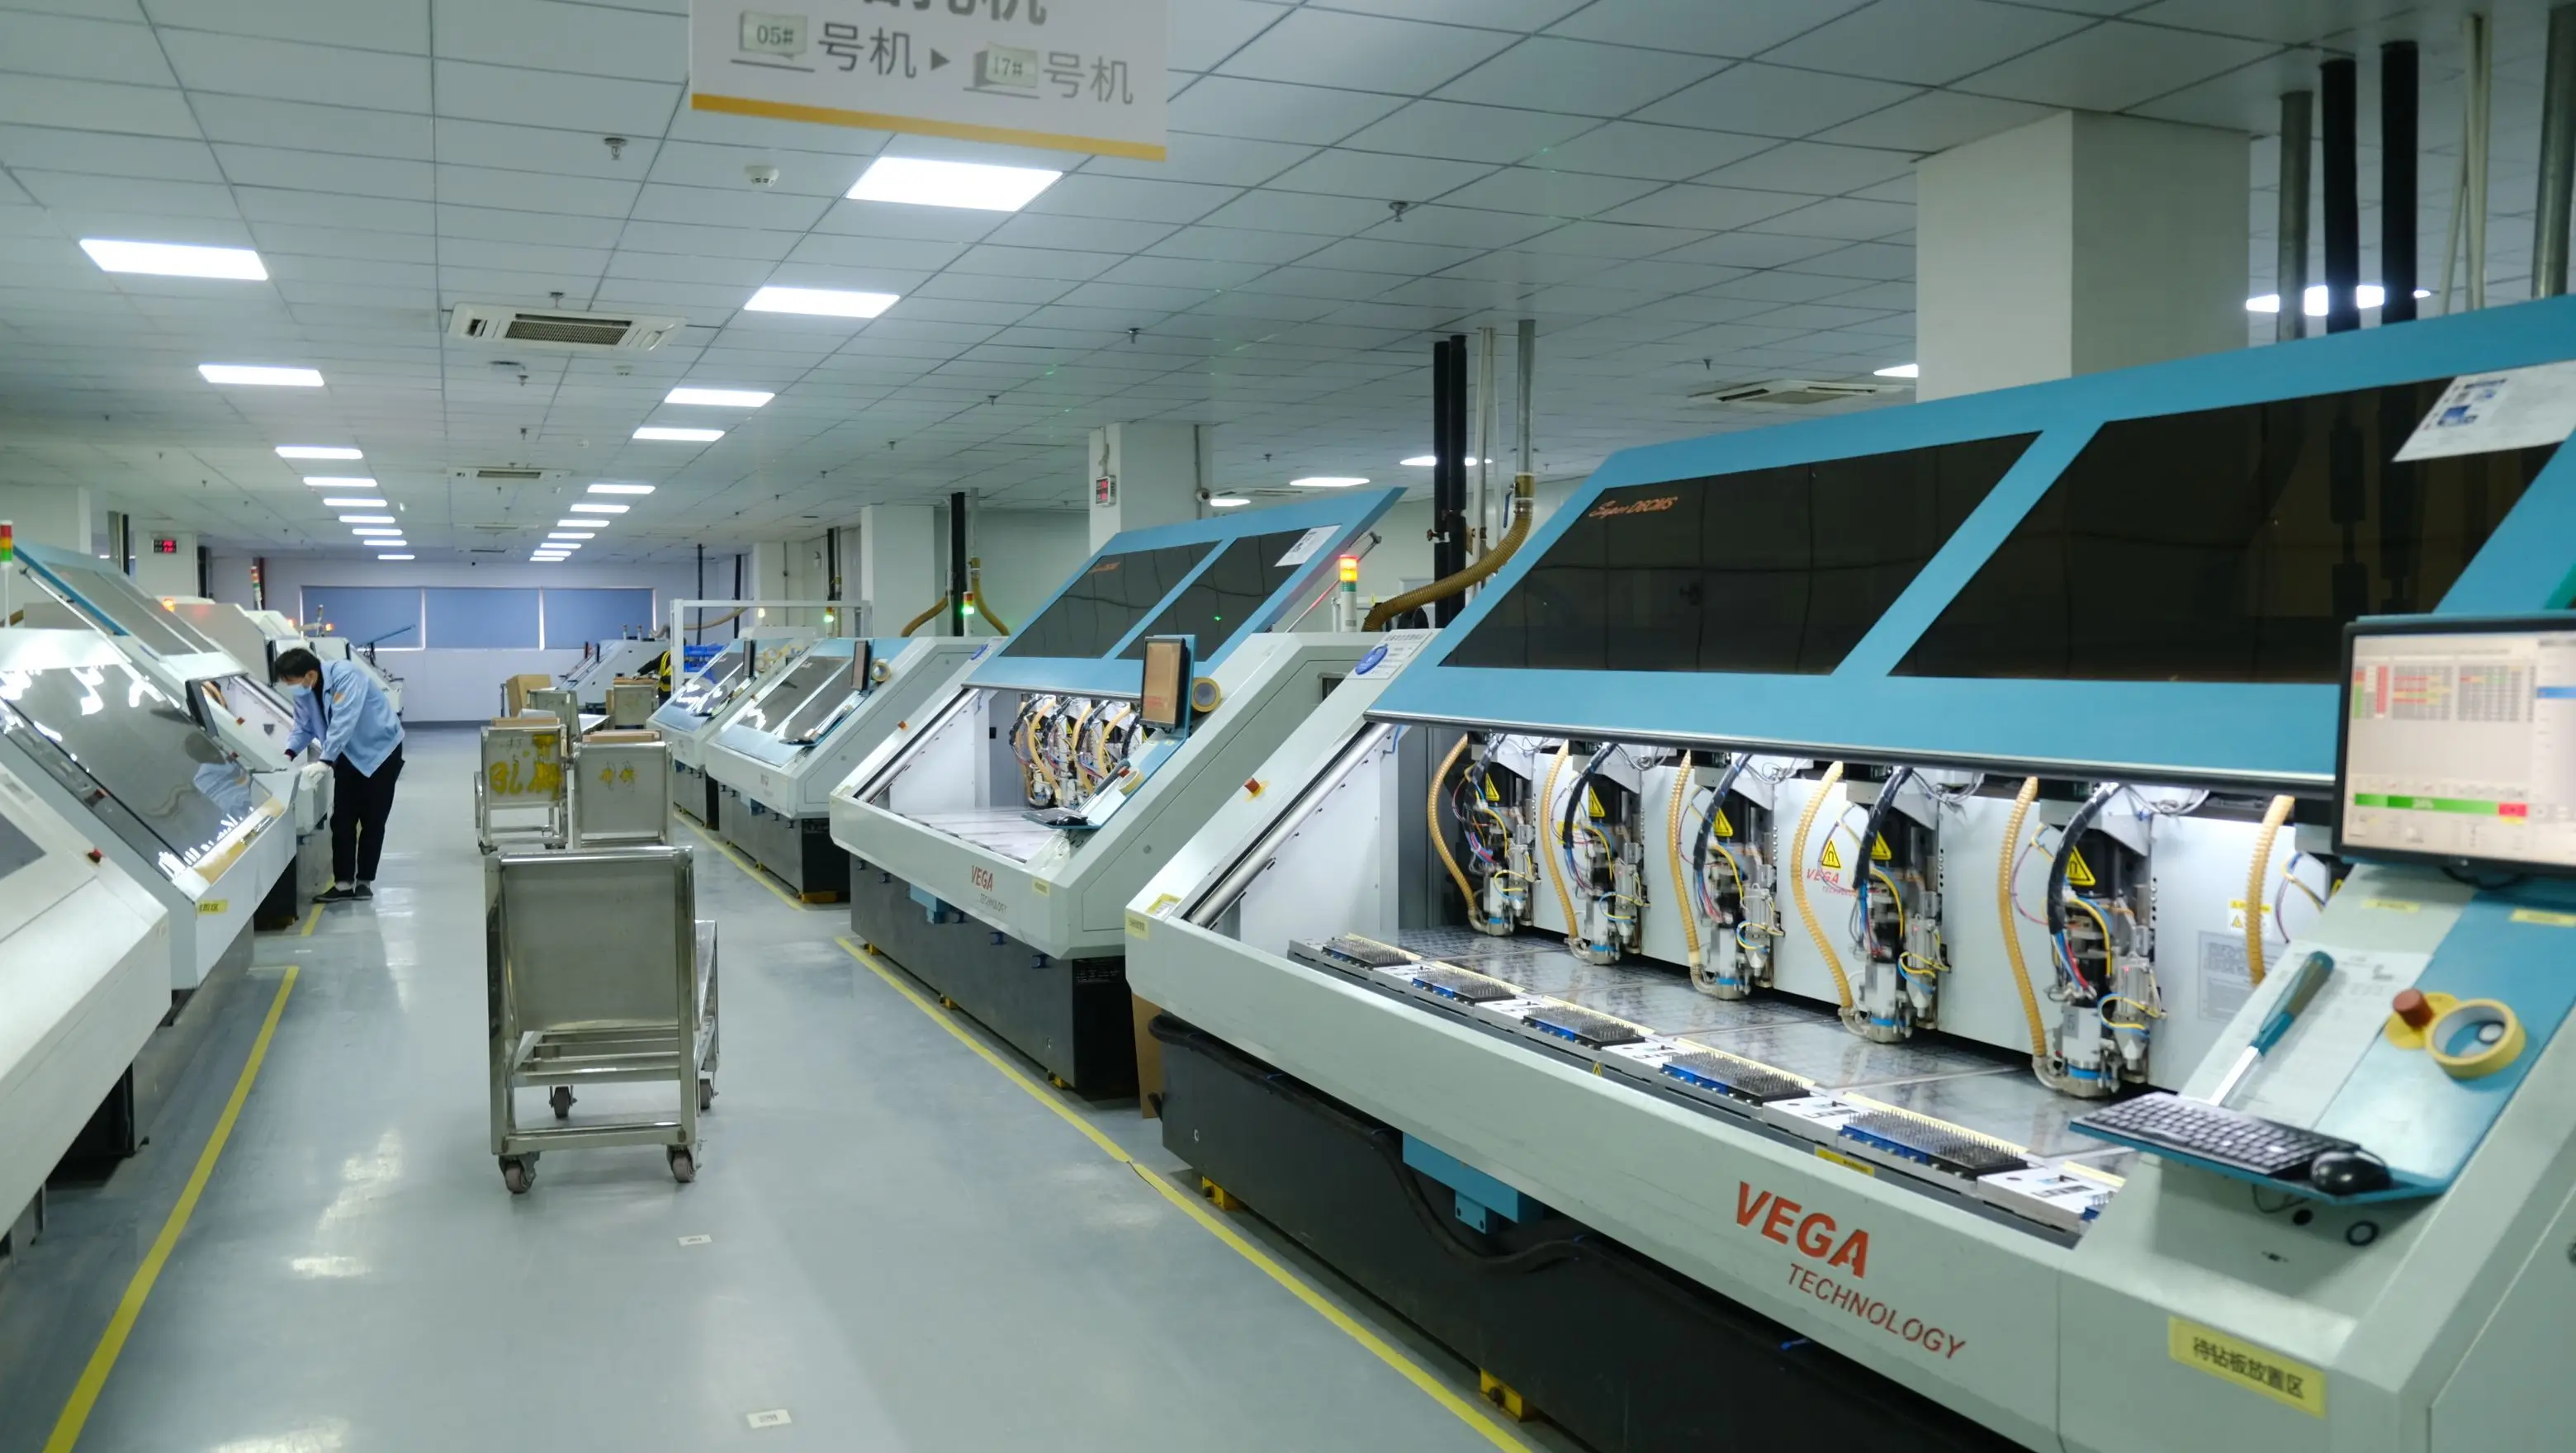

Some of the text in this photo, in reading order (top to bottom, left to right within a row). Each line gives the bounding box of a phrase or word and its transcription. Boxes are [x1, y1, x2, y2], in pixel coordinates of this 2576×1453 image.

[756, 21, 1134, 106] 05# 号机 17# 号机
[971, 864, 994, 892] VEGA
[1807, 868, 1840, 884] VEGA
[2067, 1014, 2076, 1031] 5
[1735, 1181, 1871, 1279] VEGA
[1788, 1262, 1966, 1361] TECHNOLOGY
[2192, 1336, 2306, 1400] 待钻板放置区
